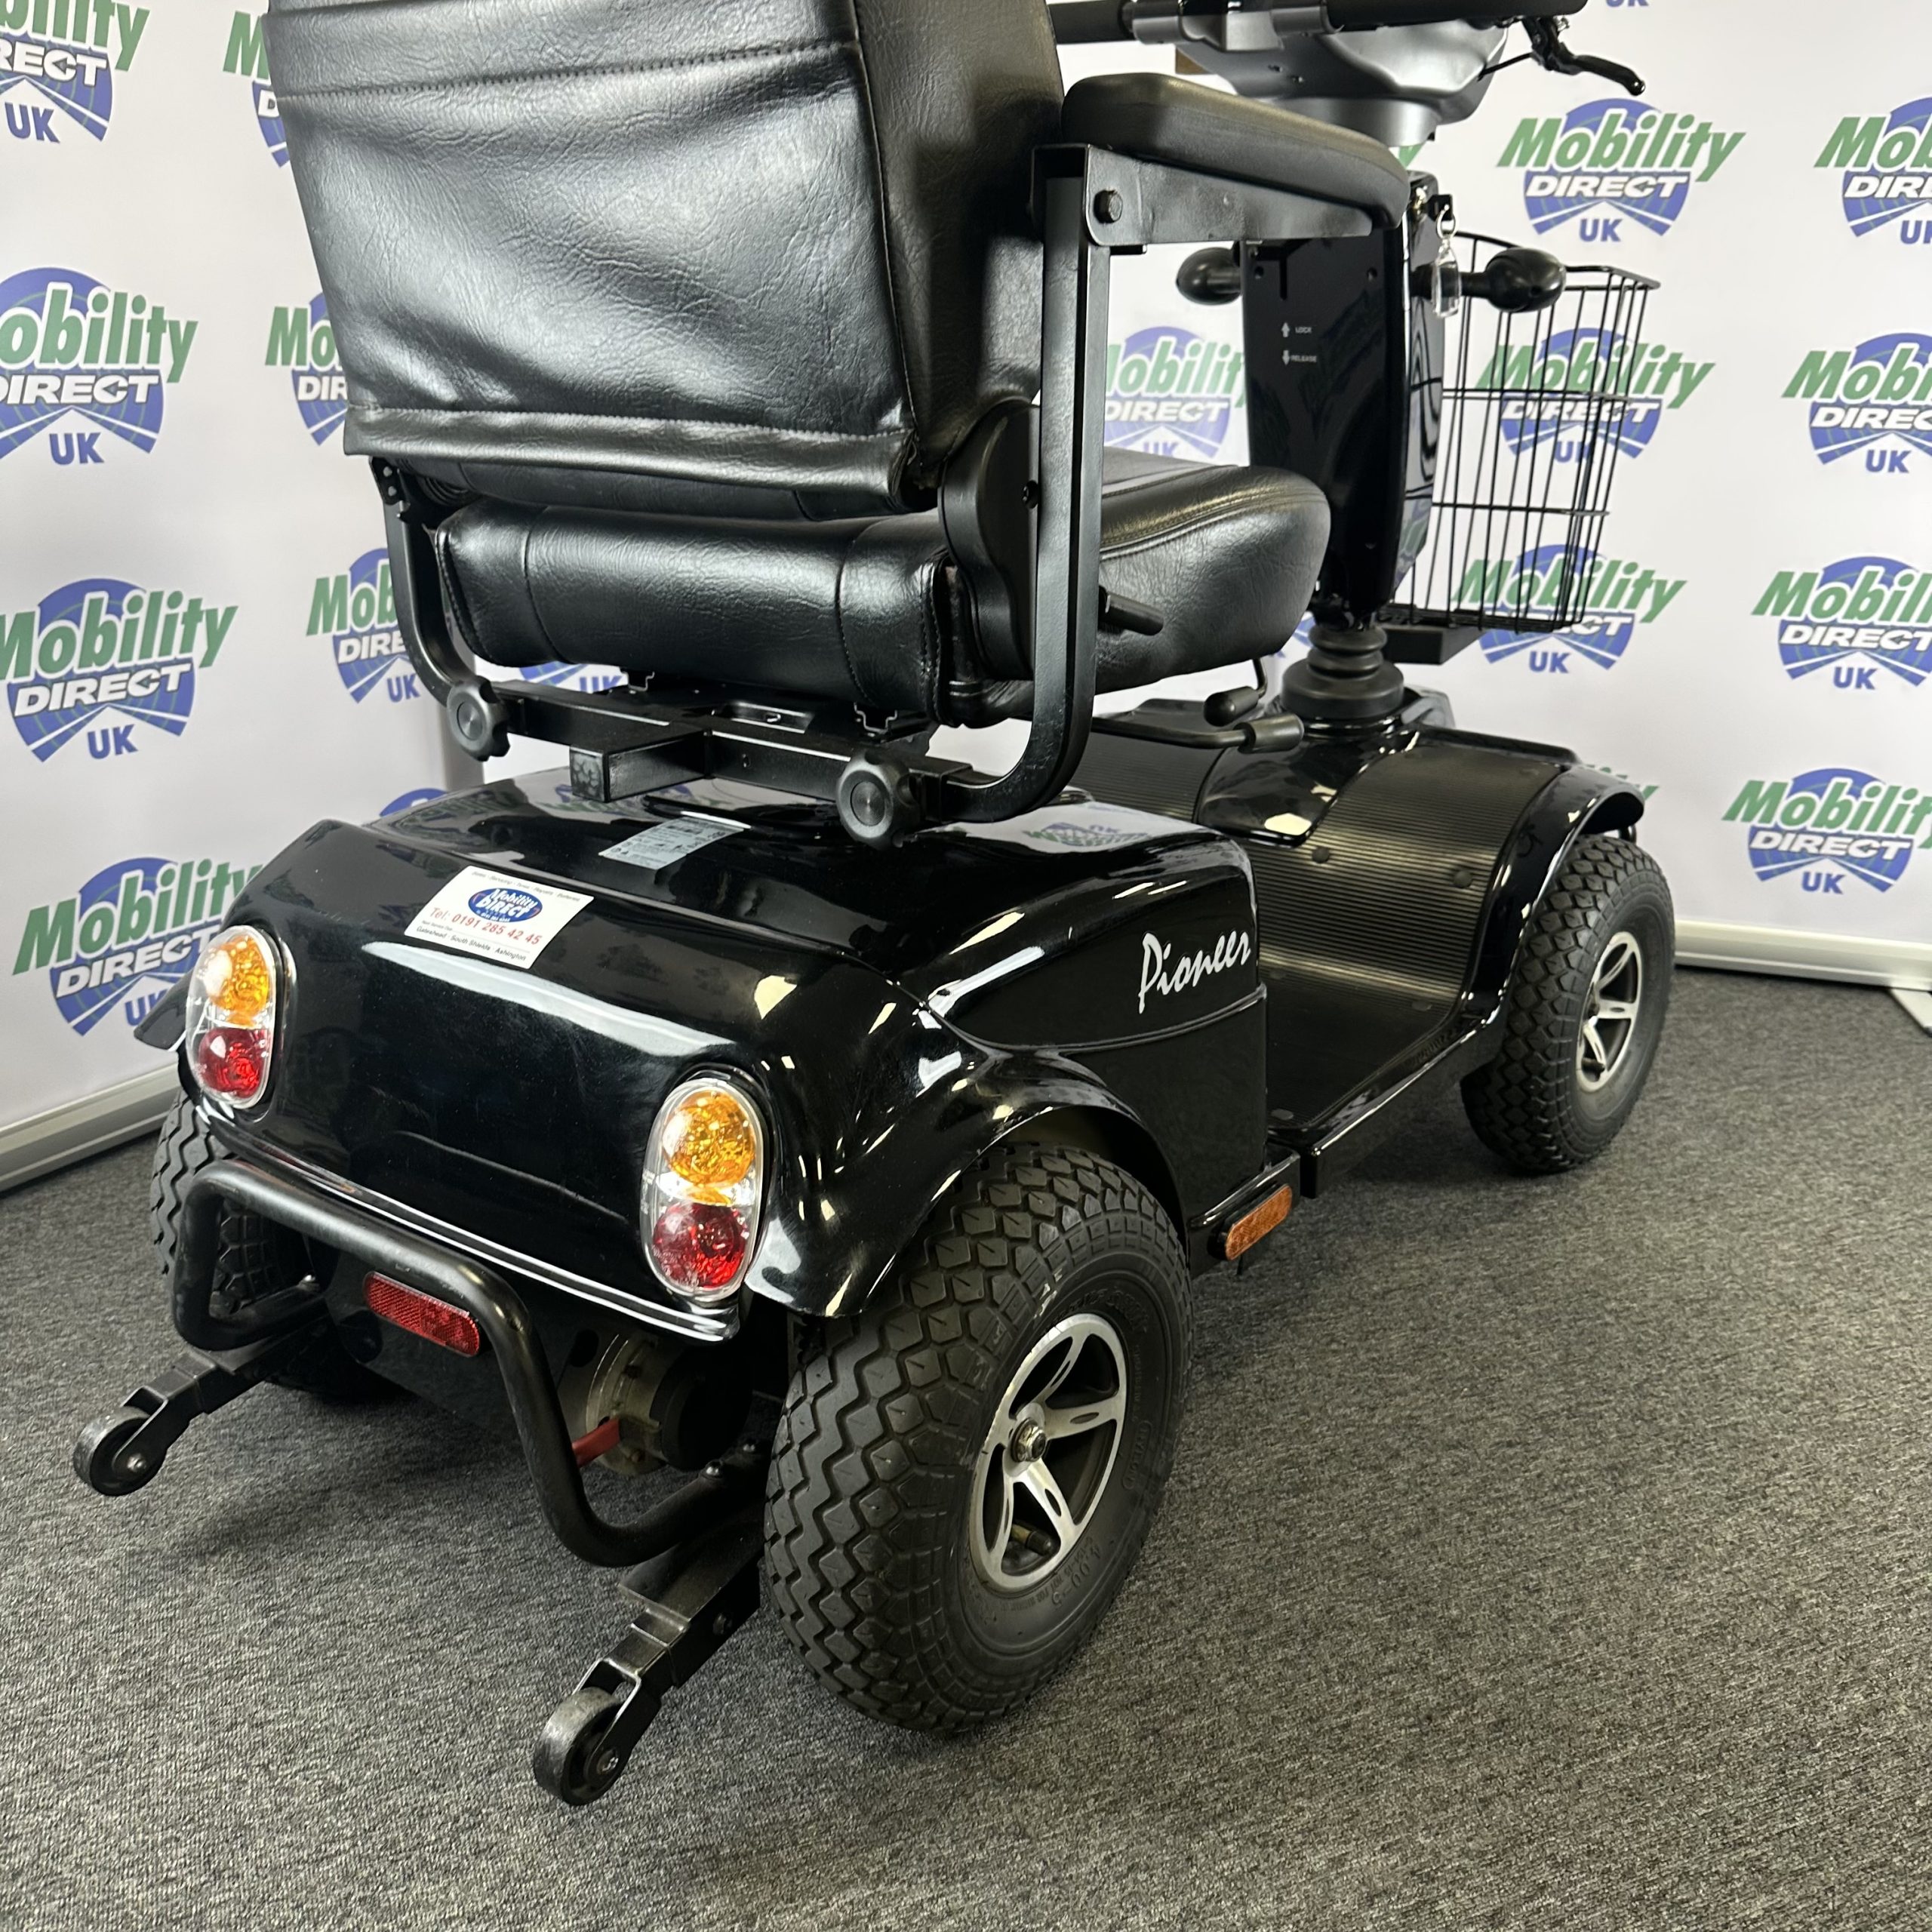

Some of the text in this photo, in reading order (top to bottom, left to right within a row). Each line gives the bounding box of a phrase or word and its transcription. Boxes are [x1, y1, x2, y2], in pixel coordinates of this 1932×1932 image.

[5, 102, 60, 143] UK
[1496, 112, 1746, 182] Mobility
[1525, 175, 1687, 198] DIRECT
[1844, 176, 1932, 198] DIR
[1579, 219, 1623, 242] UK
[0, 289, 198, 383] obility
[1107, 340, 1245, 408] obilit
[1475, 342, 1715, 409] Mobility
[0, 375, 159, 405] IRECT
[297, 376, 348, 401] DIR
[1105, 401, 1229, 423] DIRECT
[1502, 402, 1660, 423] DIRECT
[1811, 406, 1932, 430] DIREC
[49, 432, 104, 465] UK
[1866, 450, 1912, 473] UK
[338, 630, 405, 664] DIRE
[1780, 624, 1932, 652] DIRECT
[1529, 651, 1571, 674] UK
[14, 663, 192, 717] DIRECT
[386, 674, 420, 703] UK
[1833, 666, 1878, 691] UK
[88, 724, 138, 759] UK
[1749, 830, 1912, 860] DIRECT
[1802, 872, 1846, 895] UK
[475, 894, 530, 918] DIRECT
[489, 888, 539, 913] Mobility
[430, 907, 450, 920] Tel:
[451, 914, 481, 929] 0191
[481, 921, 506, 935] 285
[507, 929, 525, 940] 42
[525, 934, 543, 945] 45
[451, 935, 469, 945] South
[468, 940, 491, 951] Shields
[494, 947, 527, 961] Ashington
[1138, 931, 1251, 1014] Pioneer
